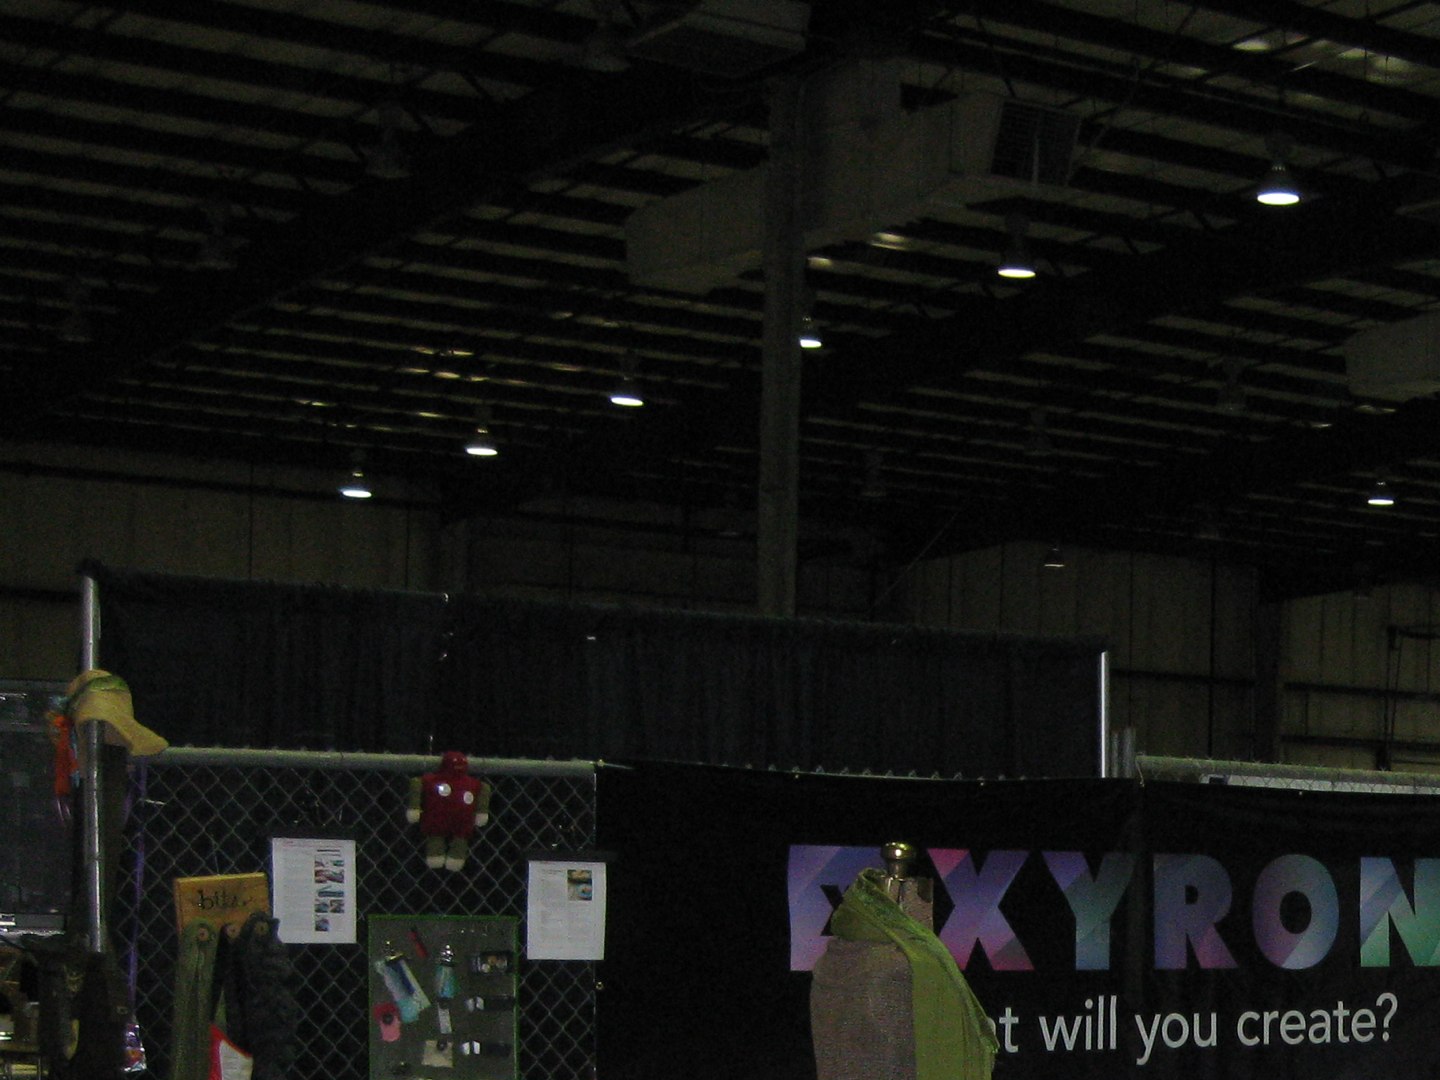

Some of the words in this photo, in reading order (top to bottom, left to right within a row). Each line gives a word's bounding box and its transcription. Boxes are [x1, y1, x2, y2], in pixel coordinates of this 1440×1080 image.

[1039, 995, 1117, 1051] will
[1135, 1011, 1217, 1066] you
[1236, 993, 1398, 1049] create?
